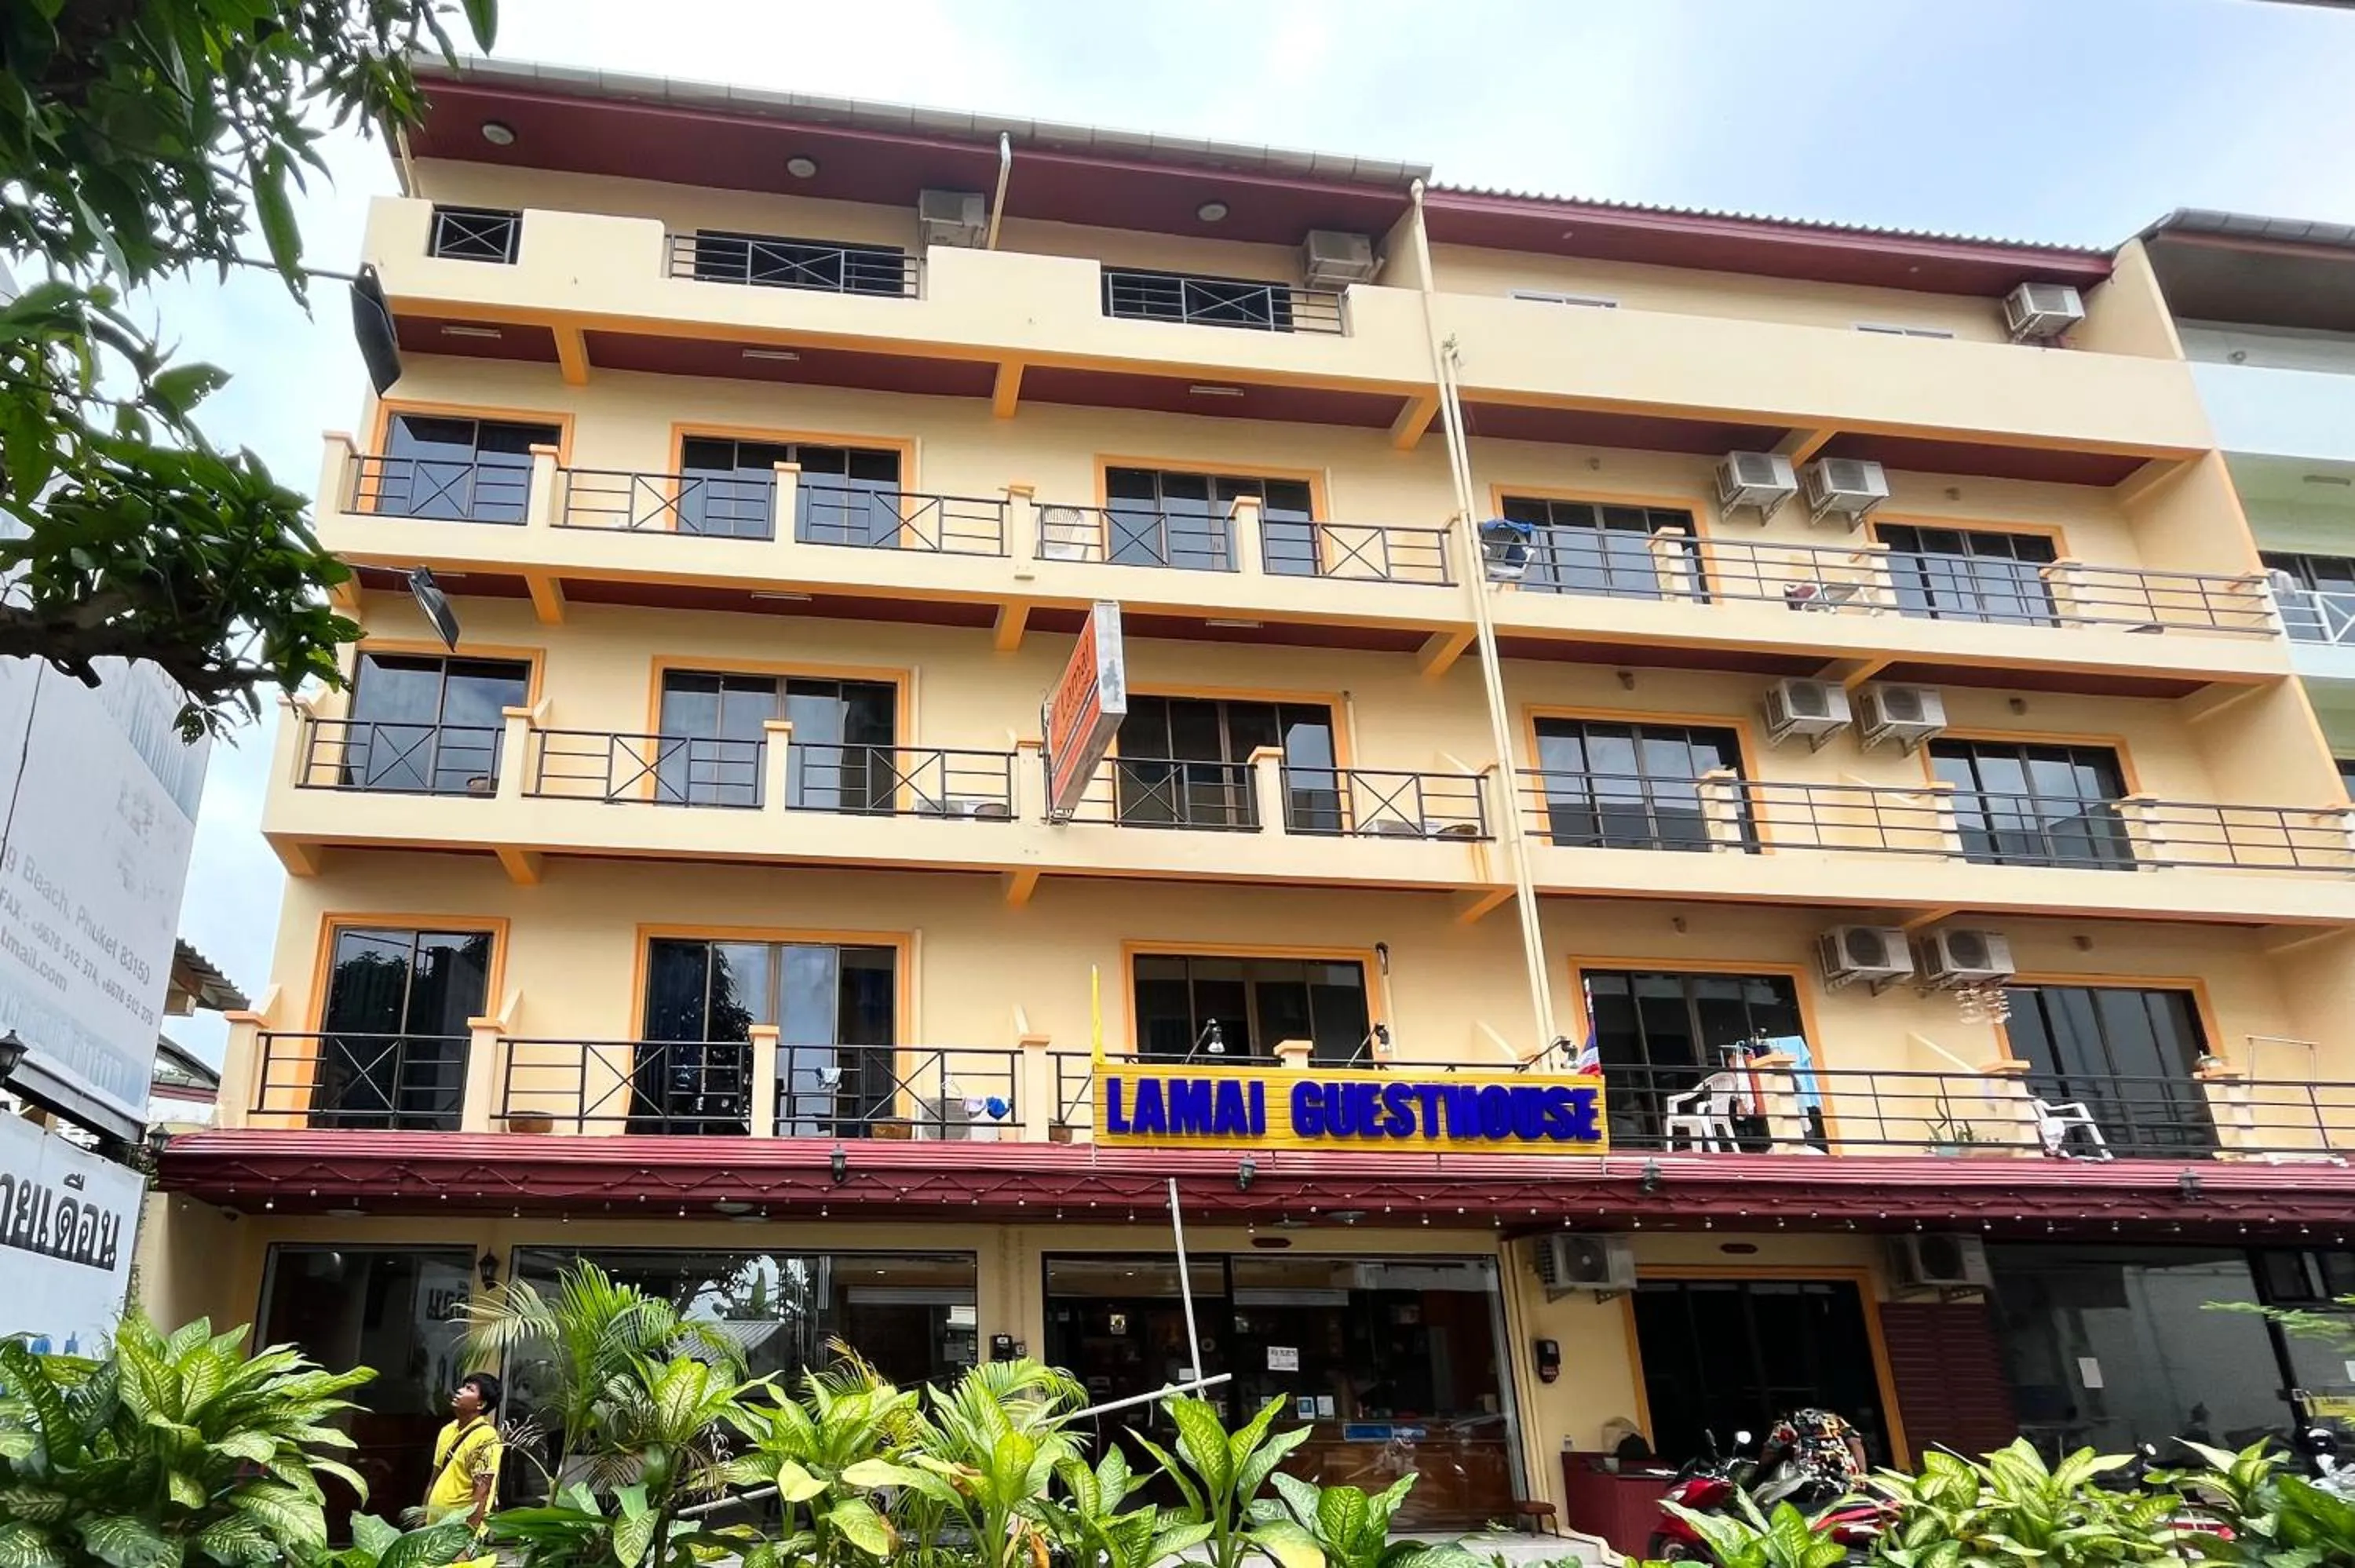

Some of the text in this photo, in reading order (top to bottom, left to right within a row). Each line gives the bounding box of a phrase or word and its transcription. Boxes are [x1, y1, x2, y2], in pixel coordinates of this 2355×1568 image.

[75, 905, 119, 958] Phuket
[120, 945, 151, 986] 83150
[1105, 1077, 1603, 1141] LAMAI GUESTHOUSE
